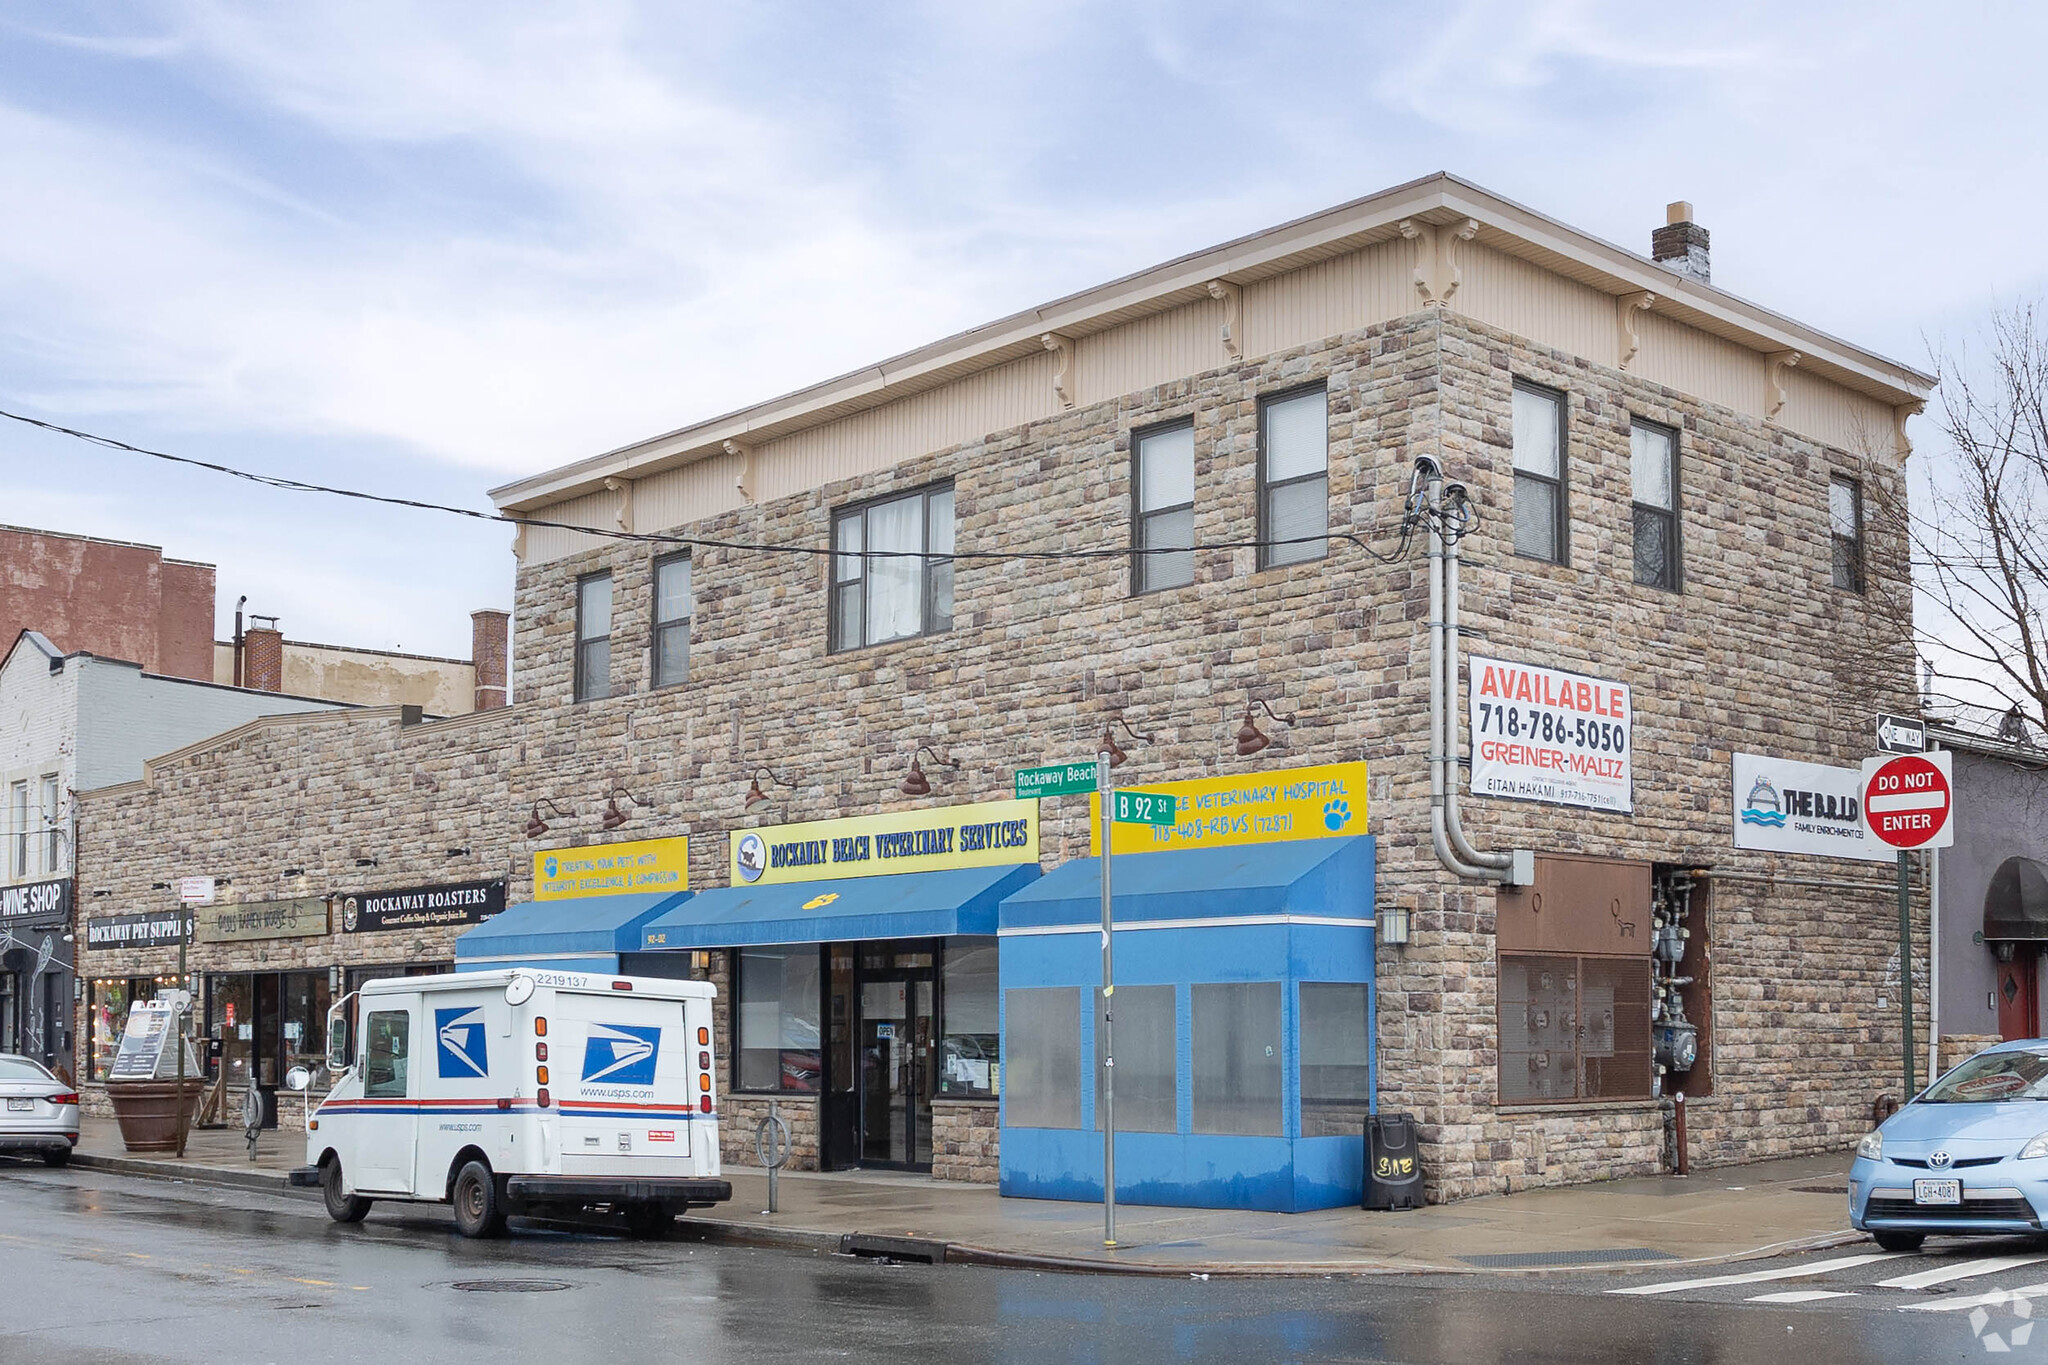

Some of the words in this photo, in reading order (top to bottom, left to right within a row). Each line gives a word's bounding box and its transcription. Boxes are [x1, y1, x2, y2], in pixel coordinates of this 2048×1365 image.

[1480, 665, 1624, 719] AVAILABLE
[1479, 702, 1624, 754] 718-786-5050
[1883, 725, 1898, 742] ONE
[1905, 730, 1921, 745] WAY
[1481, 740, 1624, 780] GREINER-MALTZ
[1018, 771, 1064, 787] Rockaway
[1067, 766, 1096, 782] Beach
[1878, 775, 1899, 791] DO
[1904, 772, 1934, 789] NOT
[1196, 785, 1279, 809] VETERINARY
[1283, 779, 1348, 801] HOSPITAL
[1487, 778, 1517, 795] EITAN
[1518, 782, 1555, 798] HAKAMI
[1120, 796, 1129, 818] B
[1135, 798, 1152, 820] 92
[1158, 799, 1167, 813] St
[1783, 789, 1813, 817] THE
[1150, 814, 1249, 842] 718-408-RBVS
[1254, 812, 1293, 833] (7287)
[1794, 822, 1816, 834] FAMILY
[1816, 825, 1856, 838] ENRICHMENT
[1883, 814, 1932, 831] ENTER
[771, 839, 828, 868] ROCKAWAY
[832, 835, 870, 862] BEACH
[875, 827, 954, 859] VETERINARY
[960, 819, 1028, 852] SERVICES
[561, 861, 595, 872] TREATING
[597, 857, 614, 869] YOUR
[617, 855, 634, 868] PETS
[638, 853, 657, 866] WITH
[635, 870, 679, 885] COMPASSION
[3, 887, 29, 916] WINE
[30, 883, 61, 913] SHOP
[365, 894, 425, 913] ROCKAWAY
[428, 888, 487, 908] ROASTERS
[459, 909, 468, 919] Bar
[89, 924, 131, 943] ROCKAWAY
[132, 922, 149, 940] PET
[150, 919, 193, 938] SUPPLIS
[537, 973, 588, 987] 2219137
[879, 1026, 894, 1036] OPEN
[580, 1088, 654, 1099] www.usps.com
